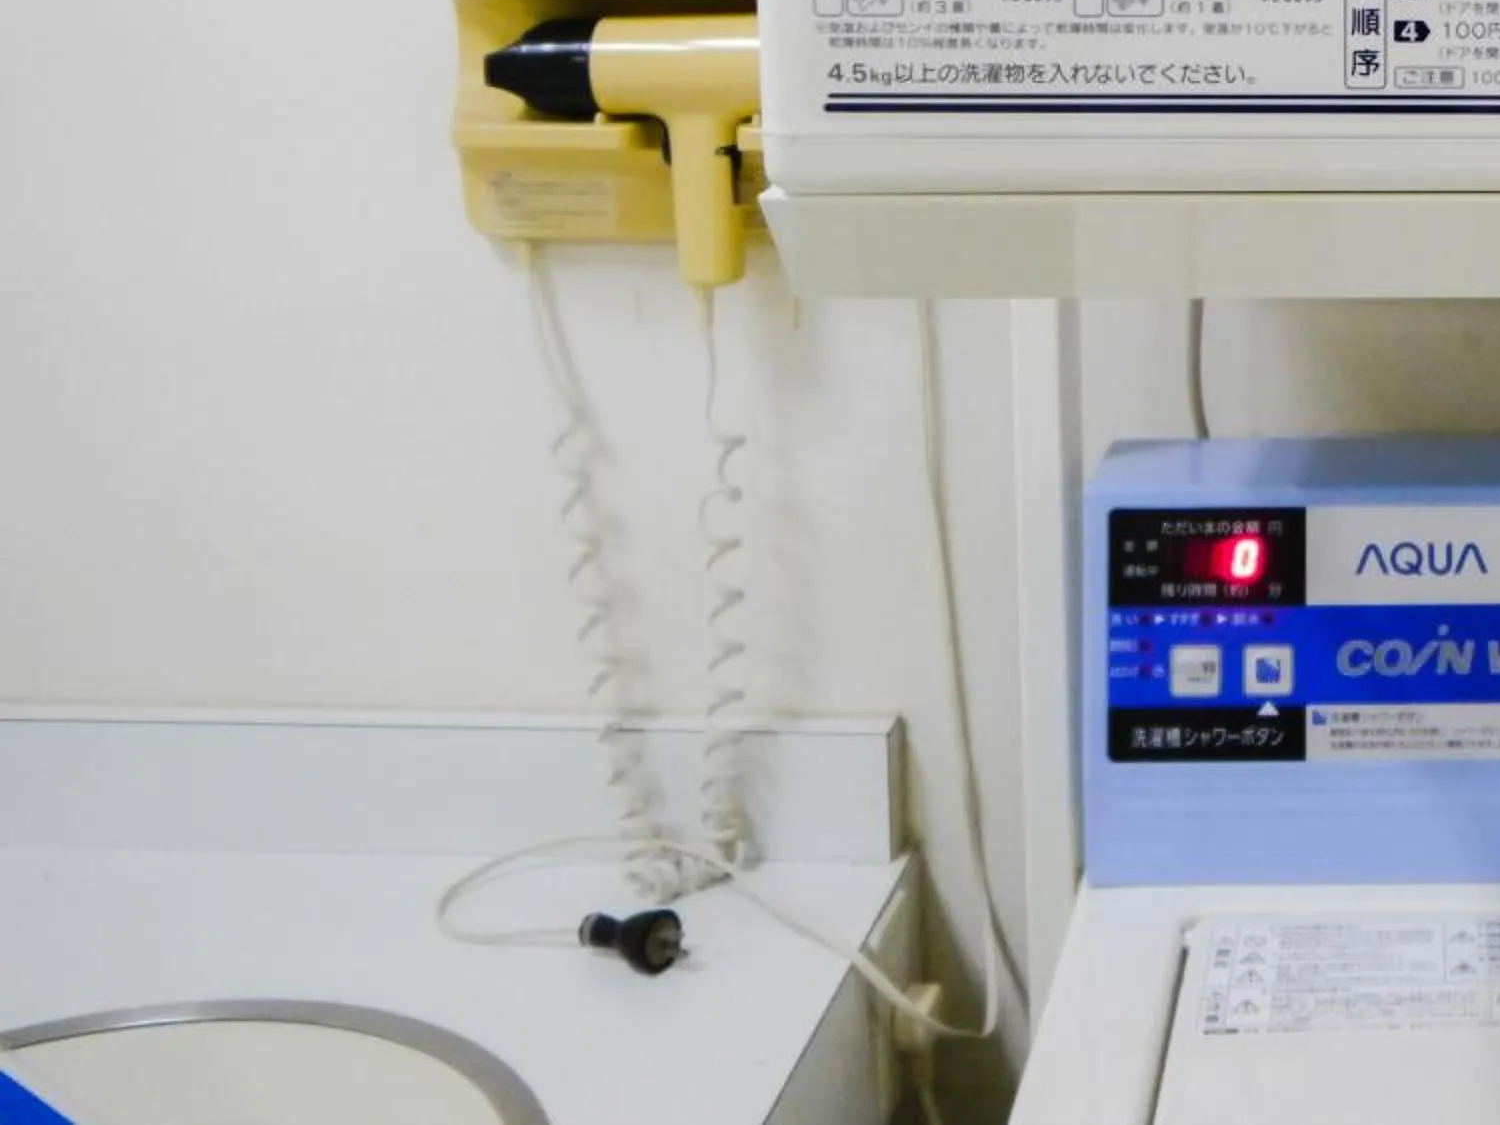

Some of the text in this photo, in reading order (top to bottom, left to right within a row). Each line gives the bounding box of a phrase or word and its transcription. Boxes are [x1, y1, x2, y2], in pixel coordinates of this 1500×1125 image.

[827, 62, 1258, 87] 4.5kg以上の洗濯物を入れないでください。
[1161, 520, 1284, 536] ただいまの金額 円
[1231, 538, 1260, 578] 0
[1356, 541, 1489, 576] AQUA
[1131, 726, 1286, 749] 洗濯槽シャワーボタン
